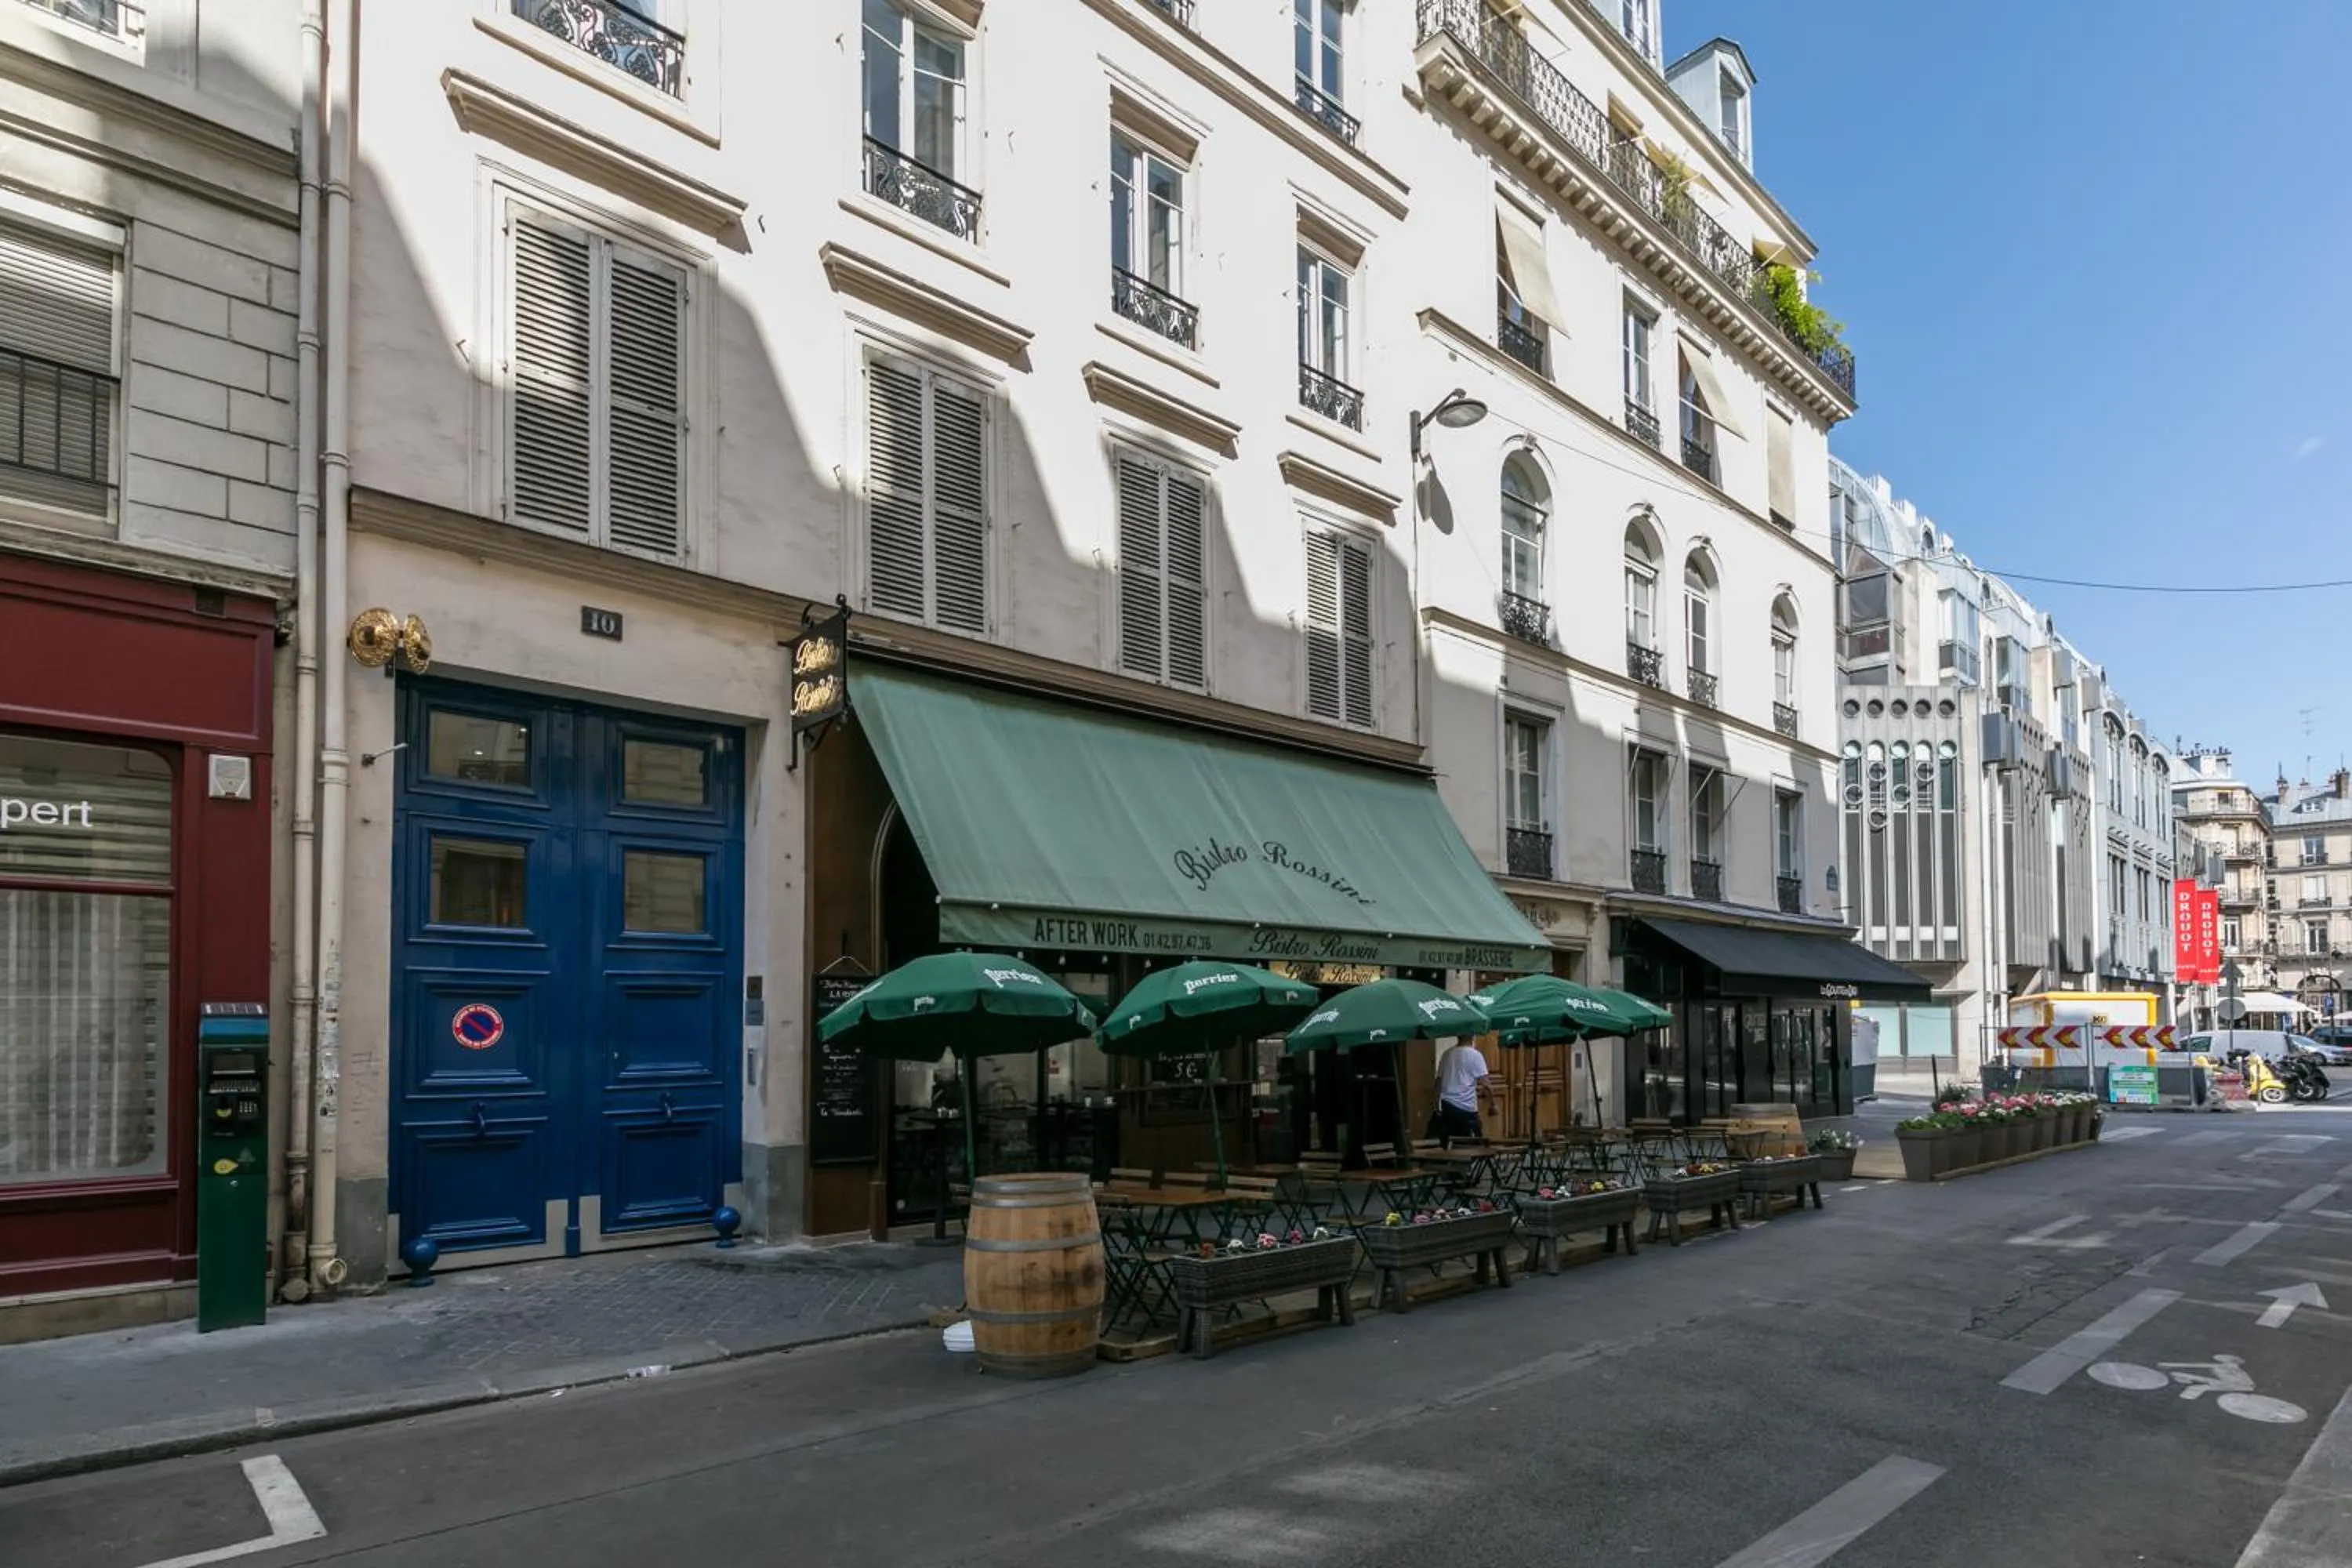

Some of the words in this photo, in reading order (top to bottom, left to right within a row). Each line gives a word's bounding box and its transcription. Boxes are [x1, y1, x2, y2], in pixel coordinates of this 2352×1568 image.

[591, 612, 615, 634] 10
[0, 798, 93, 829] pert
[1174, 837, 1248, 891] Bistro
[1261, 840, 1377, 905] Rossini
[1034, 916, 1088, 945] AFTER
[1091, 921, 1139, 947] WORK
[2179, 891, 2193, 953] DROUOT
[2200, 901, 2214, 959] DROUOT
[1249, 927, 1310, 956] Bistro
[1314, 931, 1381, 960] Rossini
[1182, 972, 1239, 996] perrier
